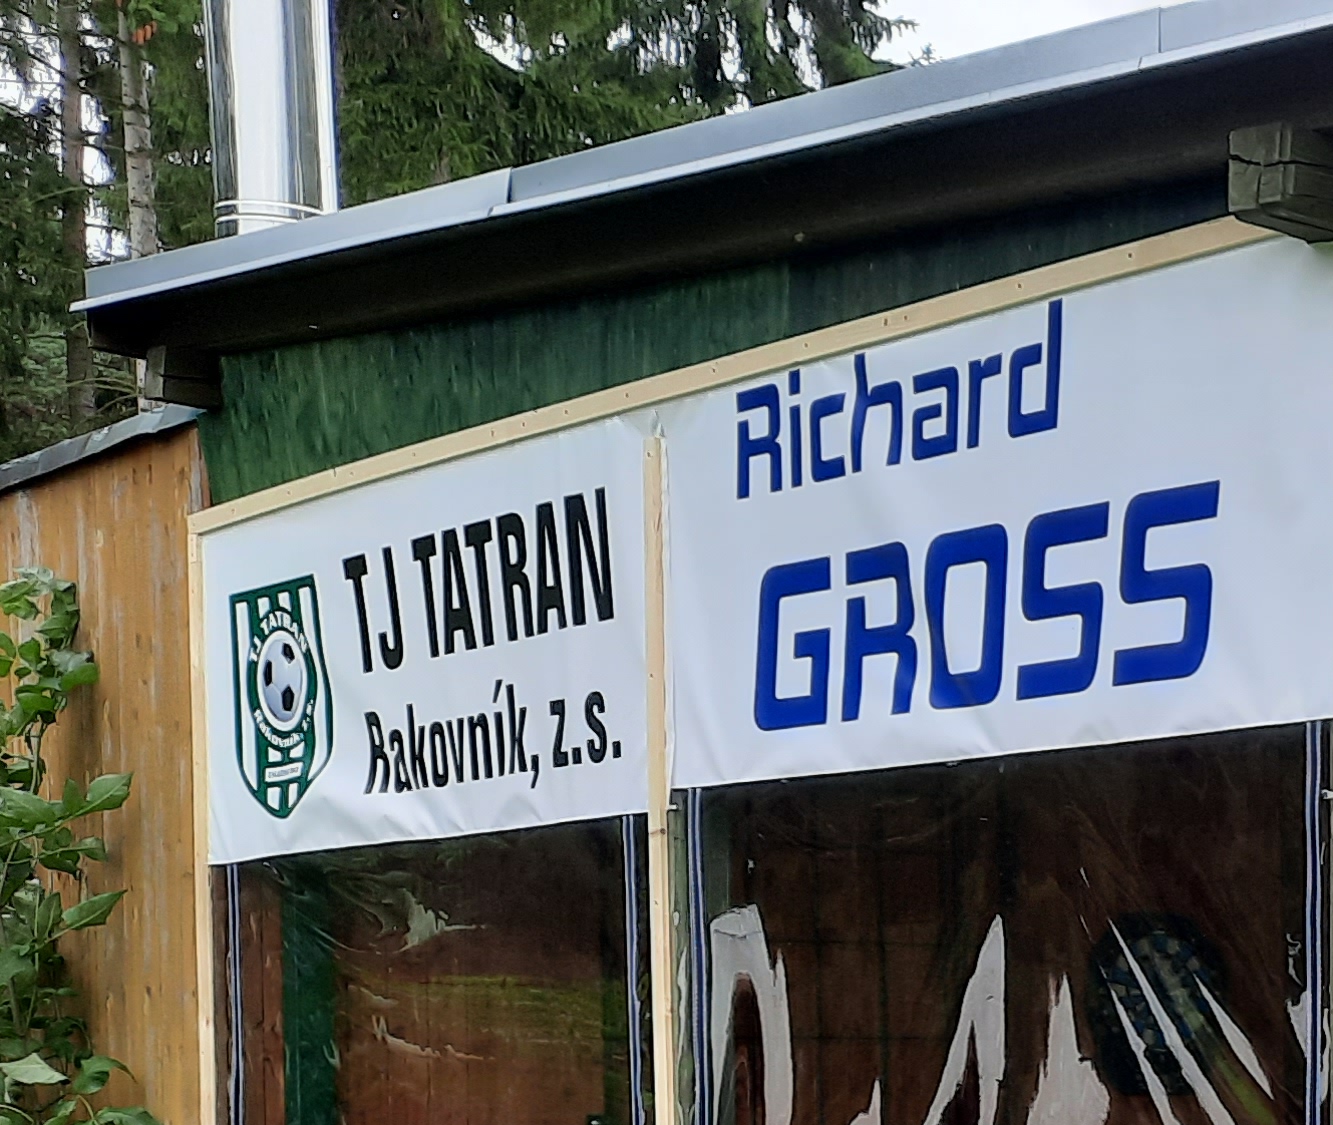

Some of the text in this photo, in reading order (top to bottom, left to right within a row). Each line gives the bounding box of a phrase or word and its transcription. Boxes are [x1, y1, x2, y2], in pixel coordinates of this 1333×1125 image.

[736, 299, 1063, 500] Richard
[260, 609, 309, 653] TATRAN
[342, 486, 615, 673] TJ TATRAN
[752, 480, 1221, 733] GROSS
[363, 679, 622, 795] Rakovník, z.s.
